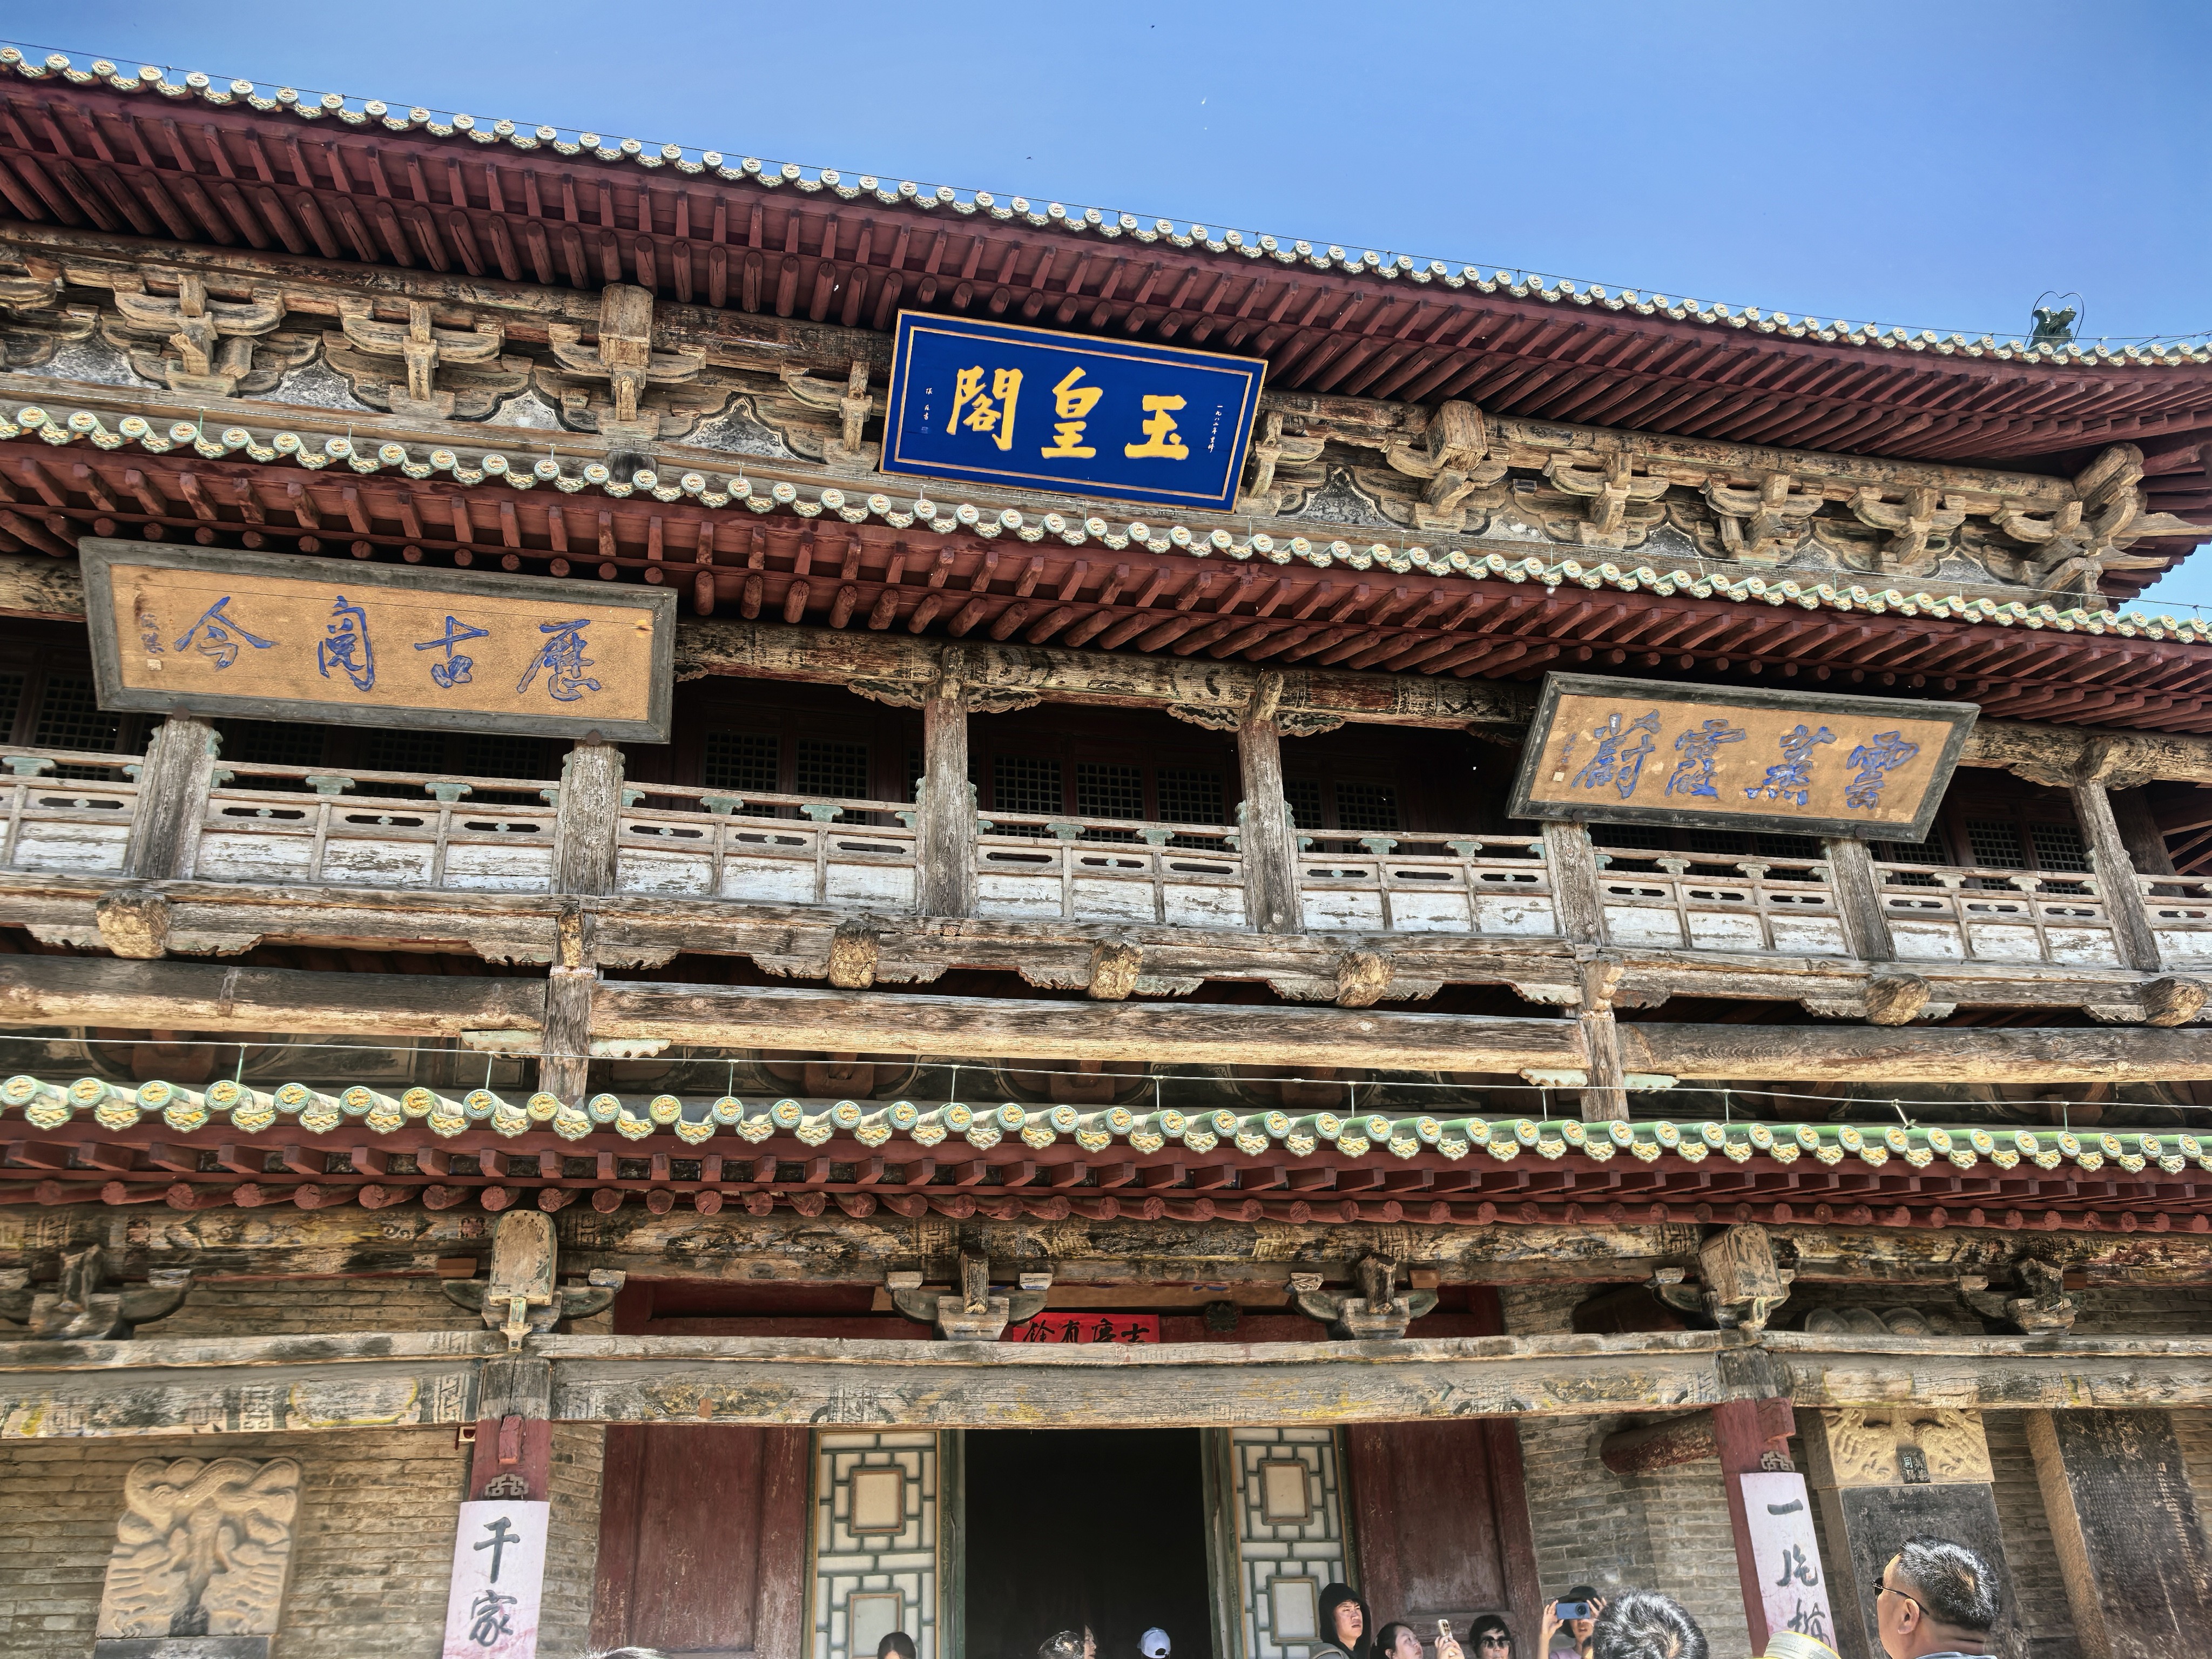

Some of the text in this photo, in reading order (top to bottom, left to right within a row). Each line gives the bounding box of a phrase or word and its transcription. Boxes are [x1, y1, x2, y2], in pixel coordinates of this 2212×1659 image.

[946, 365, 1189, 460] 玉皇閣
[468, 1516, 521, 1647] 千家
